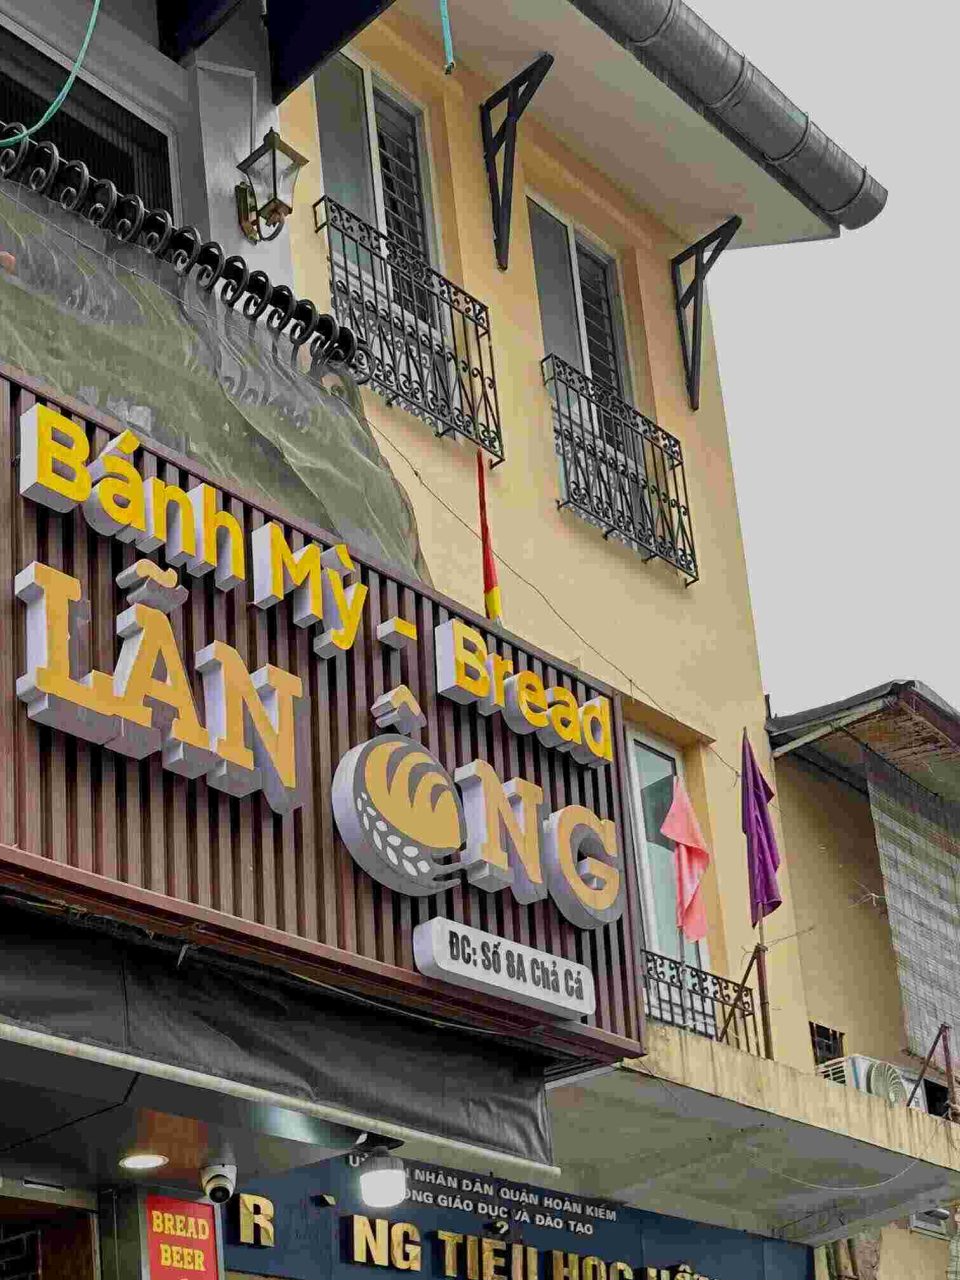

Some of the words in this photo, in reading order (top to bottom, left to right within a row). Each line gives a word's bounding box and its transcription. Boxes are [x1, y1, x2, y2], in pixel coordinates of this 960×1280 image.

[26, 403, 245, 586] Bánh
[257, 521, 368, 653] Mỳ
[439, 617, 613, 767] Bread
[16, 559, 304, 803] LÃN
[449, 930, 478, 967] ĐC:
[480, 941, 502, 974] Số
[505, 950, 527, 983] 8A
[530, 958, 560, 993] Chả
[564, 968, 584, 1000] Cá
[414, 1168, 458, 1189] NHÂN
[462, 1179, 494, 1196] DÂN
[500, 1187, 539, 1206] QUẬN
[151, 1210, 210, 1240] BREAD
[437, 1193, 473, 1211] GIÁO
[478, 1202, 508, 1220] DỤC
[514, 1207, 531, 1223] VÀ
[535, 1212, 563, 1229] ĐÀO
[568, 1219, 594, 1236] TẠO
[160, 1243, 206, 1271] BEER
